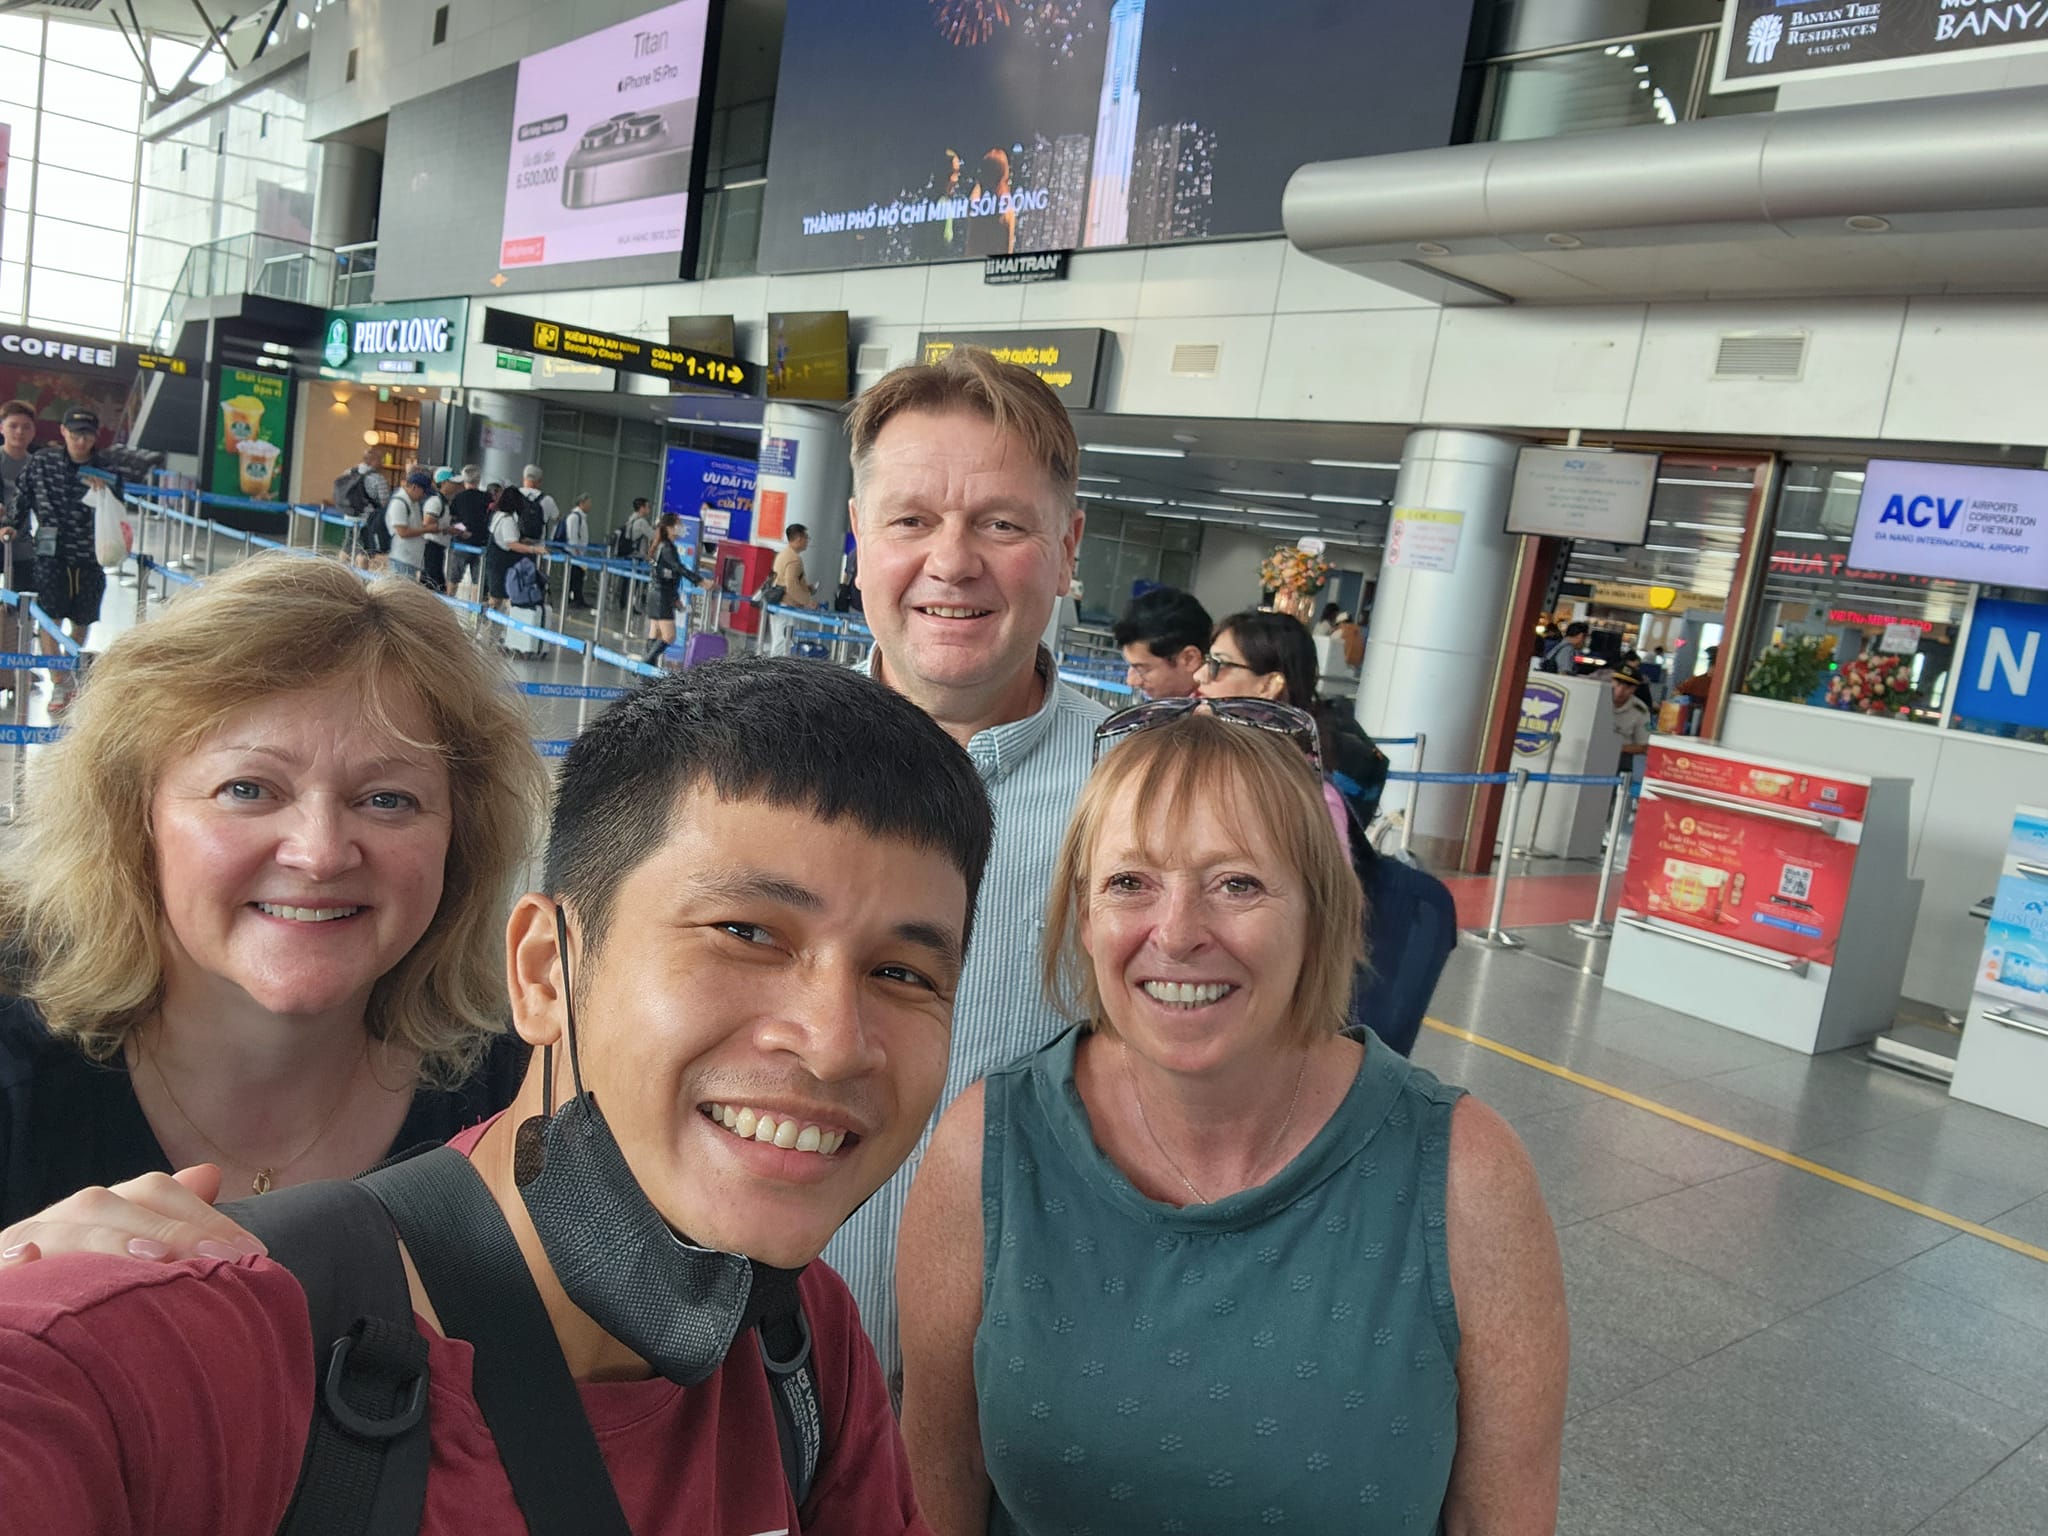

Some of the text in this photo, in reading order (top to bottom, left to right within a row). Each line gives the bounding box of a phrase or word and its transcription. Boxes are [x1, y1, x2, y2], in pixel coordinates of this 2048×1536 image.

[1790, 3, 1881, 27] BANYAN TREE
[633, 30, 669, 58] Titan
[1787, 22, 1878, 45] RESIDENCES
[623, 70, 651, 91] iPhone
[661, 64, 678, 81] Pro
[803, 211, 846, 235] THÀNH
[847, 202, 877, 229] PHỐ
[878, 200, 900, 226] HỒ
[901, 198, 927, 224] CHÍ
[928, 198, 968, 221] MINH
[969, 190, 997, 217] SÔI
[354, 317, 448, 353] PHUC LONG
[1, 334, 113, 367] COFFEE
[1879, 493, 1963, 529] ACV
[1968, 512, 2037, 527] CORPORATION
[1971, 500, 2019, 514] AIRPORTS
[1889, 532, 1915, 544] NANG
[1916, 534, 1986, 551] INTERNATIONAL
[1988, 542, 2031, 555] AIRPORT
[1966, 523, 2024, 537] OF VIETNAM
[1977, 627, 2040, 697] N
